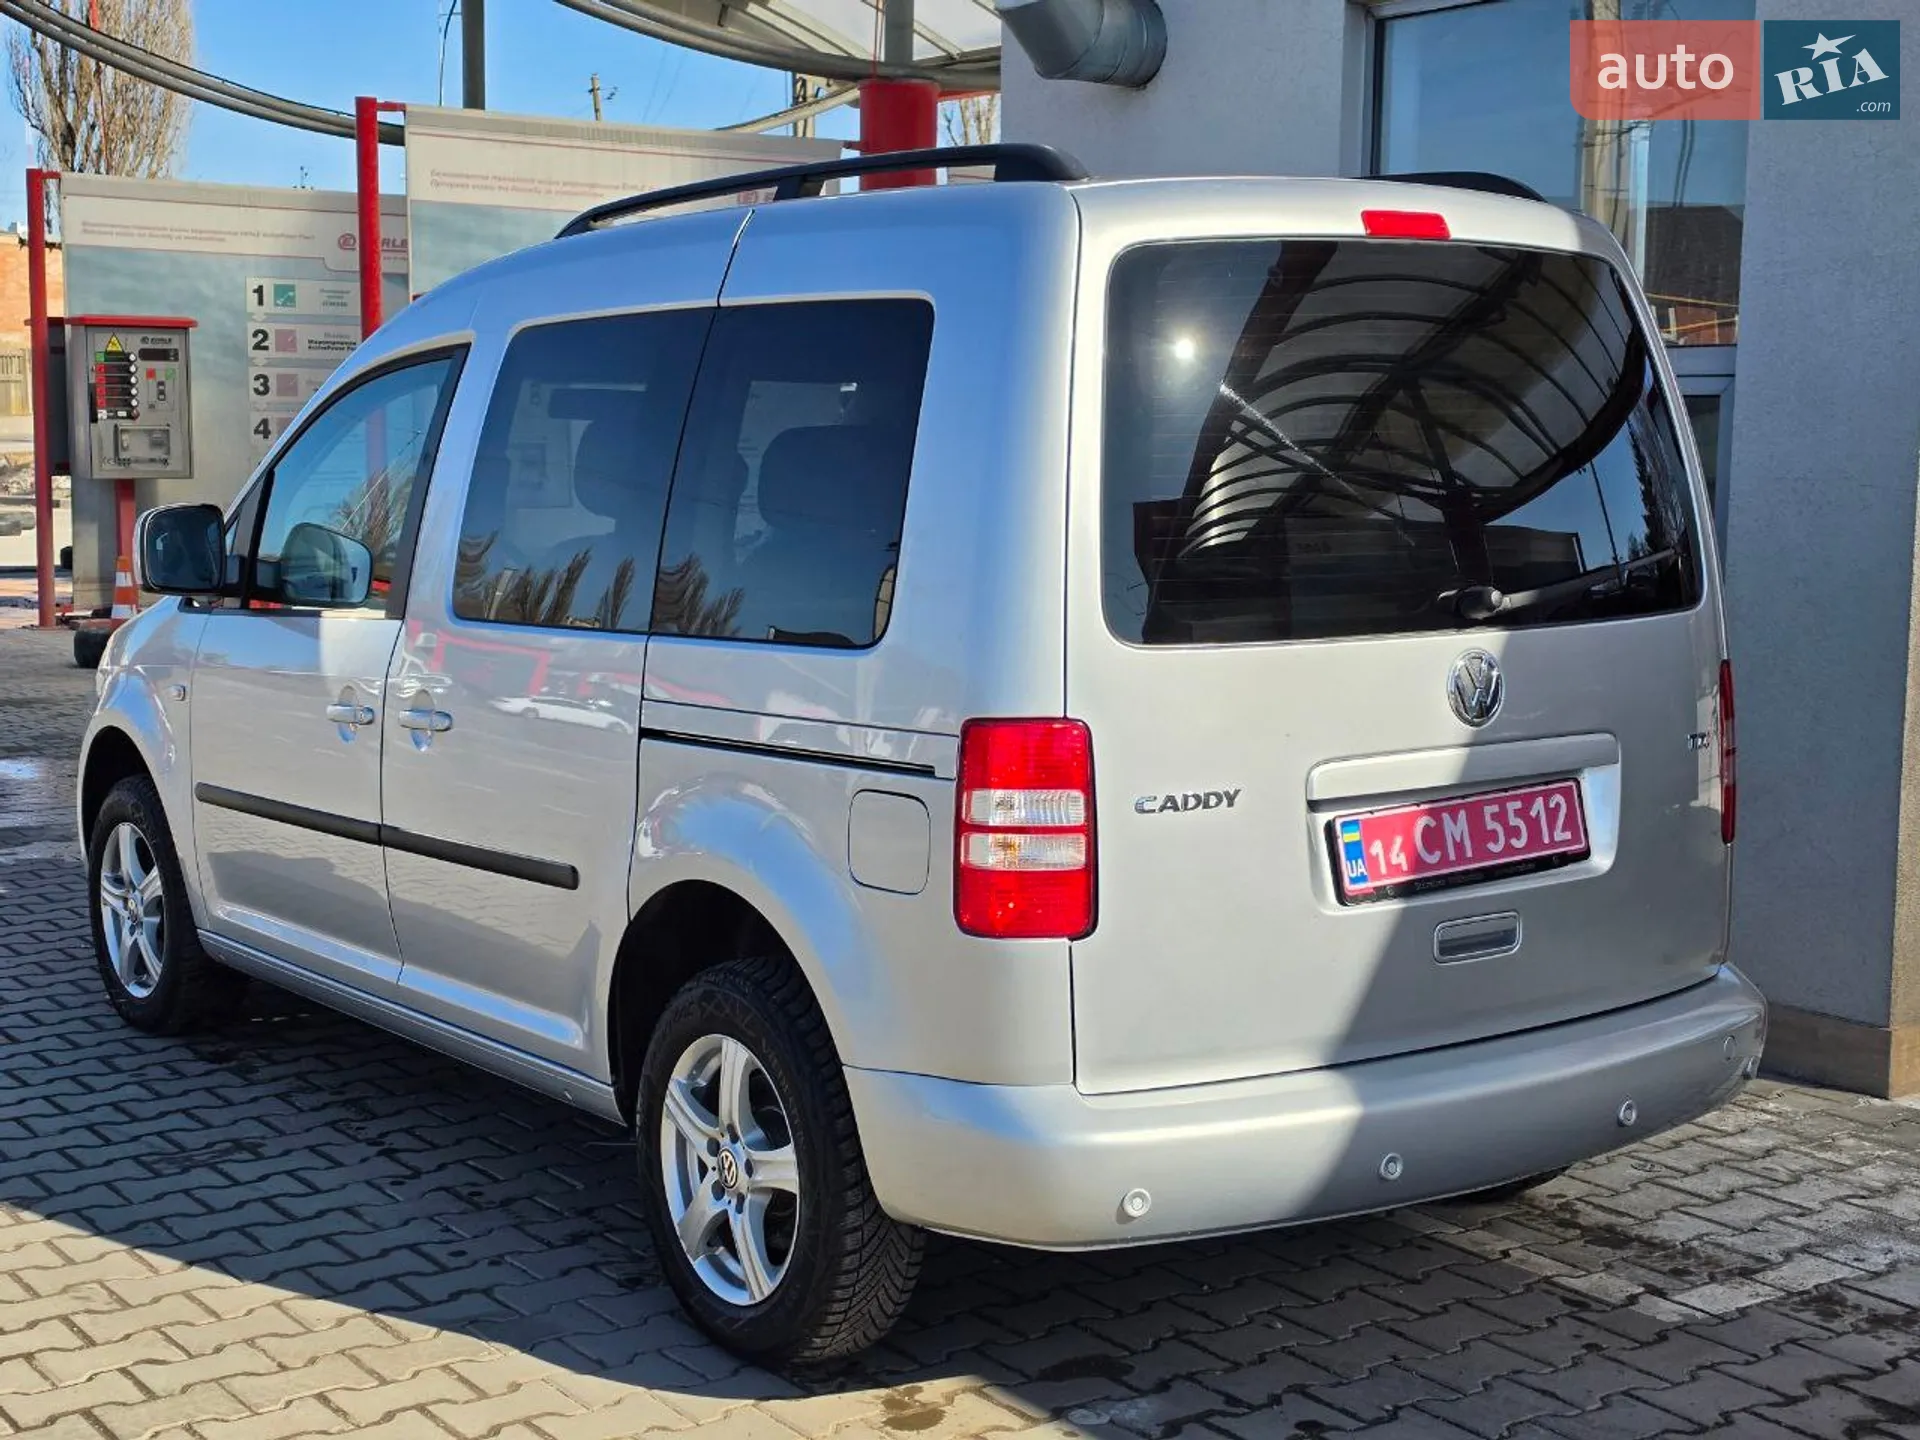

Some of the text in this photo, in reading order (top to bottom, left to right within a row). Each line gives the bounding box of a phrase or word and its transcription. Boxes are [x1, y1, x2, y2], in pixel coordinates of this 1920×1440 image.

[252, 285, 264, 306] 1
[252, 328, 270, 351] 2
[253, 373, 270, 396] 3
[253, 418, 271, 440] 4
[1134, 788, 1242, 814] CADDY
[1369, 836, 1408, 876] 14
[1414, 808, 1474, 865] CM
[1483, 793, 1572, 854] 5512
[1347, 860, 1368, 878] UA
